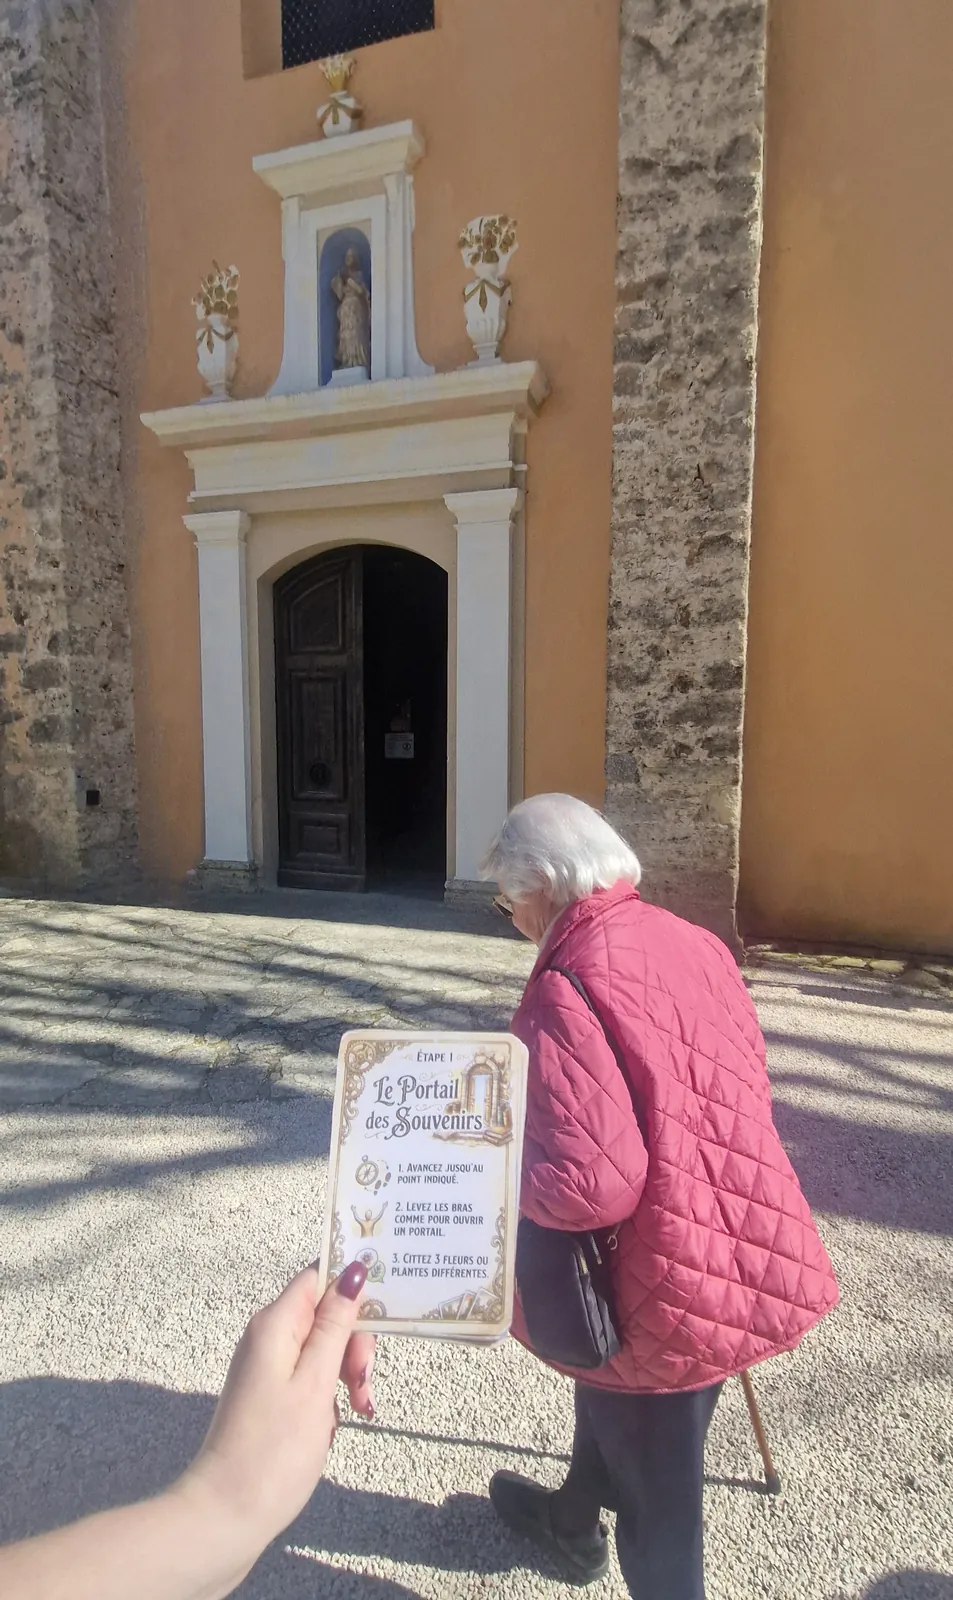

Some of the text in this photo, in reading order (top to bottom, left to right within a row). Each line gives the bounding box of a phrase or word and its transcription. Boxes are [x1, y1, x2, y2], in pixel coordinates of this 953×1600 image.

[417, 1049, 445, 1062] ÉTAPE
[373, 1074, 459, 1106] Le Portail
[365, 1106, 483, 1140] des Souvenirs
[407, 1163, 443, 1173] AVANCEZ
[445, 1163, 484, 1173] JUSQU'AU
[397, 1174, 459, 1185] POINT INDIQUÉ.
[395, 1202, 473, 1212] 2. LEVEZ LES BRAS
[394, 1215, 484, 1225] COMME POUR OUVRIR
[393, 1227, 445, 1237] UN PORTAIL.
[392, 1253, 400, 1263] 3.
[434, 1254, 440, 1264] 3
[443, 1255, 474, 1265] FLEURS
[476, 1256, 489, 1265] OU
[391, 1266, 489, 1279] PLANTES DIFFÉRENTES.
